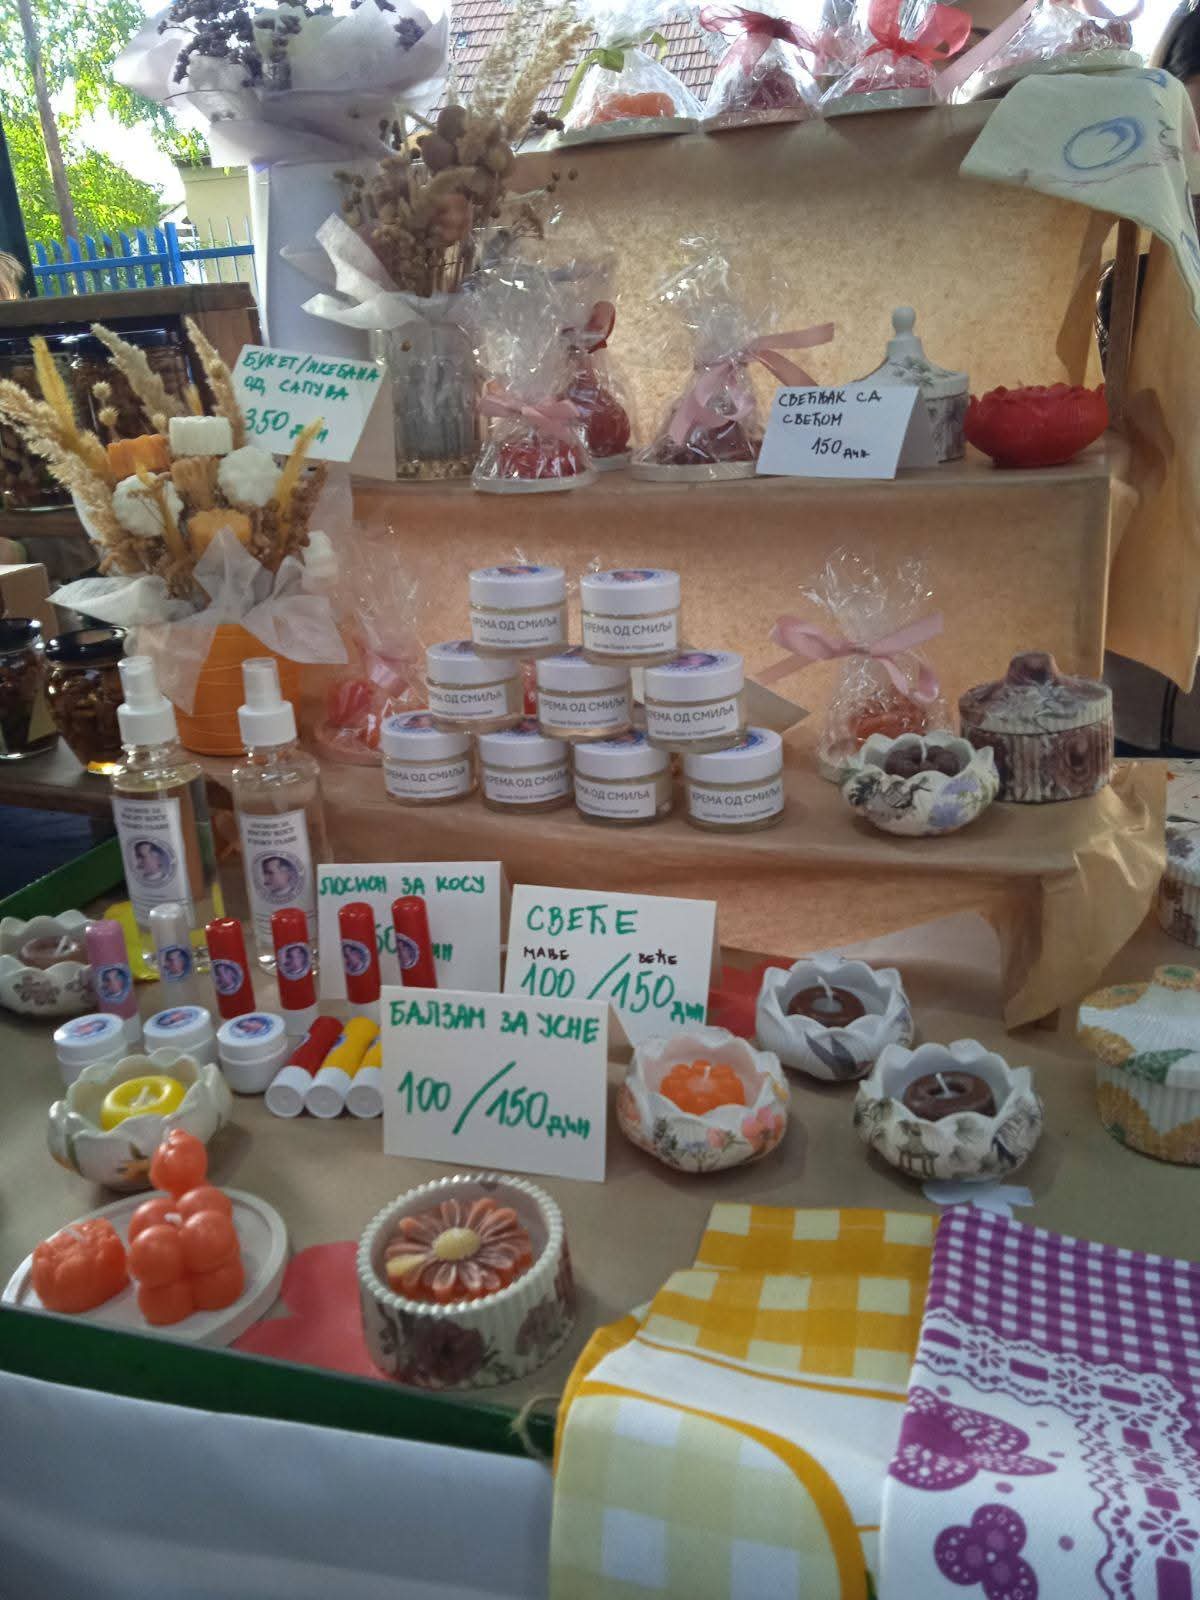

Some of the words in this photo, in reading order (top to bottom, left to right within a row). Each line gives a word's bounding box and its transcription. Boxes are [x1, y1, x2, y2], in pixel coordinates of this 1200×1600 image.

[244, 376, 265, 397] ОД
[856, 390, 882, 403] СА
[245, 408, 290, 435] 350
[811, 437, 843, 455] 150
[499, 619, 516, 632] ОД
[613, 624, 630, 637] ОД
[569, 701, 587, 713] ОД
[673, 712, 690, 724] ОД
[693, 704, 734, 720] СМИЉА
[410, 772, 427, 783] ОД
[516, 777, 533, 788] ОД
[607, 789, 650, 801] СМИЉА
[724, 795, 743, 807] ОД
[401, 877, 425, 896] ЗА
[436, 875, 485, 894] КОСУ
[526, 905, 639, 937] СВЕЋЕ
[389, 1000, 486, 1030] БАЛЗАМ
[500, 1010, 529, 1036] ЗА
[536, 1012, 600, 1044] УСНЕ
